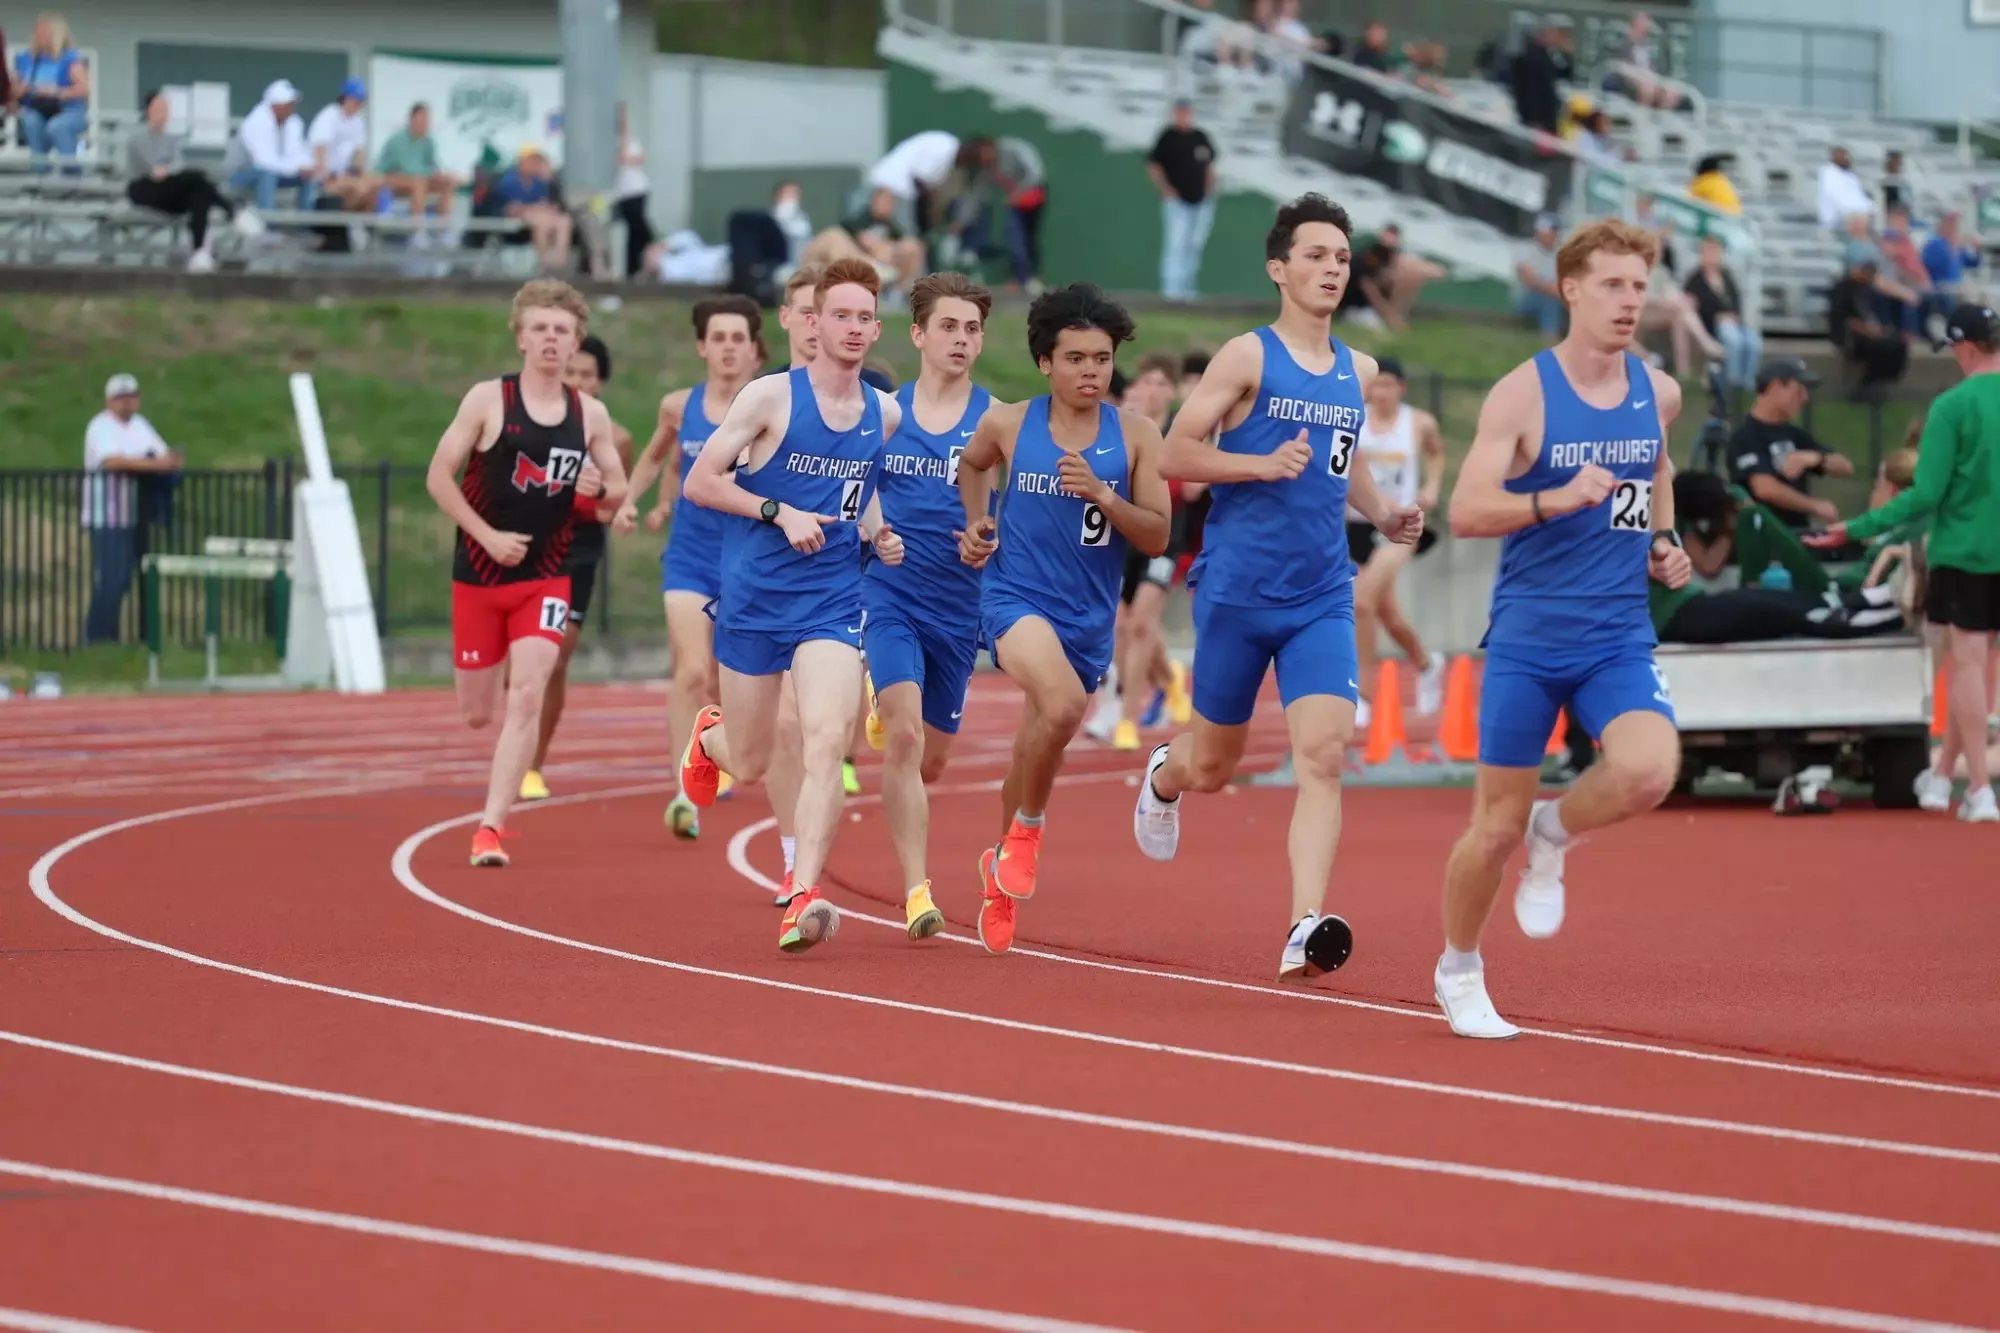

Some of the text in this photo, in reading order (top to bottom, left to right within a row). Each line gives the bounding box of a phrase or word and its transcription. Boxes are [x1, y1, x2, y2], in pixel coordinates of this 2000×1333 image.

[1267, 396, 1360, 429] ROCKHURST
[552, 455, 580, 482] 12
[786, 452, 874, 479] ROCKHURST
[885, 454, 949, 479] ROCKHU
[1330, 434, 1354, 475] 3
[1550, 439, 1660, 469] ROCKHURST
[1017, 472, 1120, 499] ROCKT
[842, 483, 861, 521] 4
[1083, 504, 1108, 545] 9
